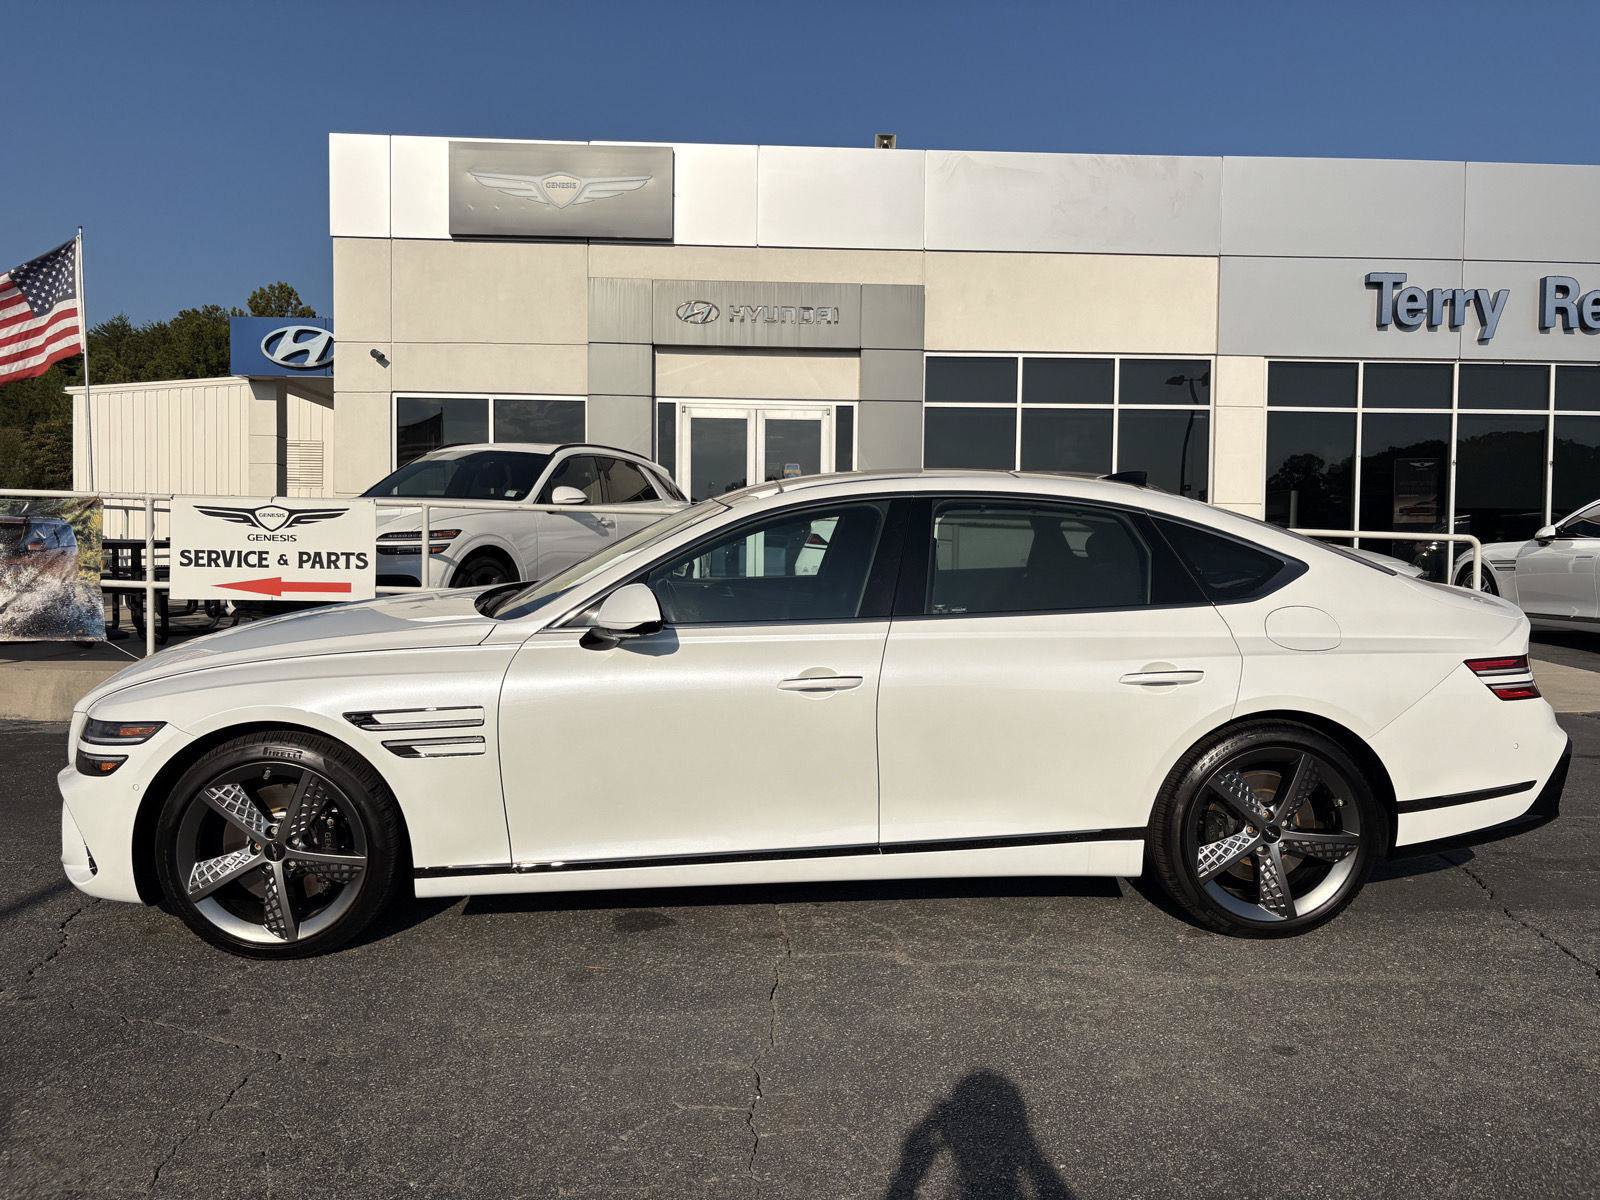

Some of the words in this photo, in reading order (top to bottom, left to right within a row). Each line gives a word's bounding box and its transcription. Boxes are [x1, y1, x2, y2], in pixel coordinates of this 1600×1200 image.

[545, 181, 577, 190] GENESIS
[1364, 271, 1511, 342] Terry
[729, 304, 840, 326] HYUNDAI
[258, 511, 286, 519] GENESIS
[247, 533, 298, 543] GENESIS
[179, 549, 270, 569] SERVICE
[277, 553, 290, 567] &
[297, 550, 369, 570] PARTS
[262, 746, 304, 760] PIRELLI
